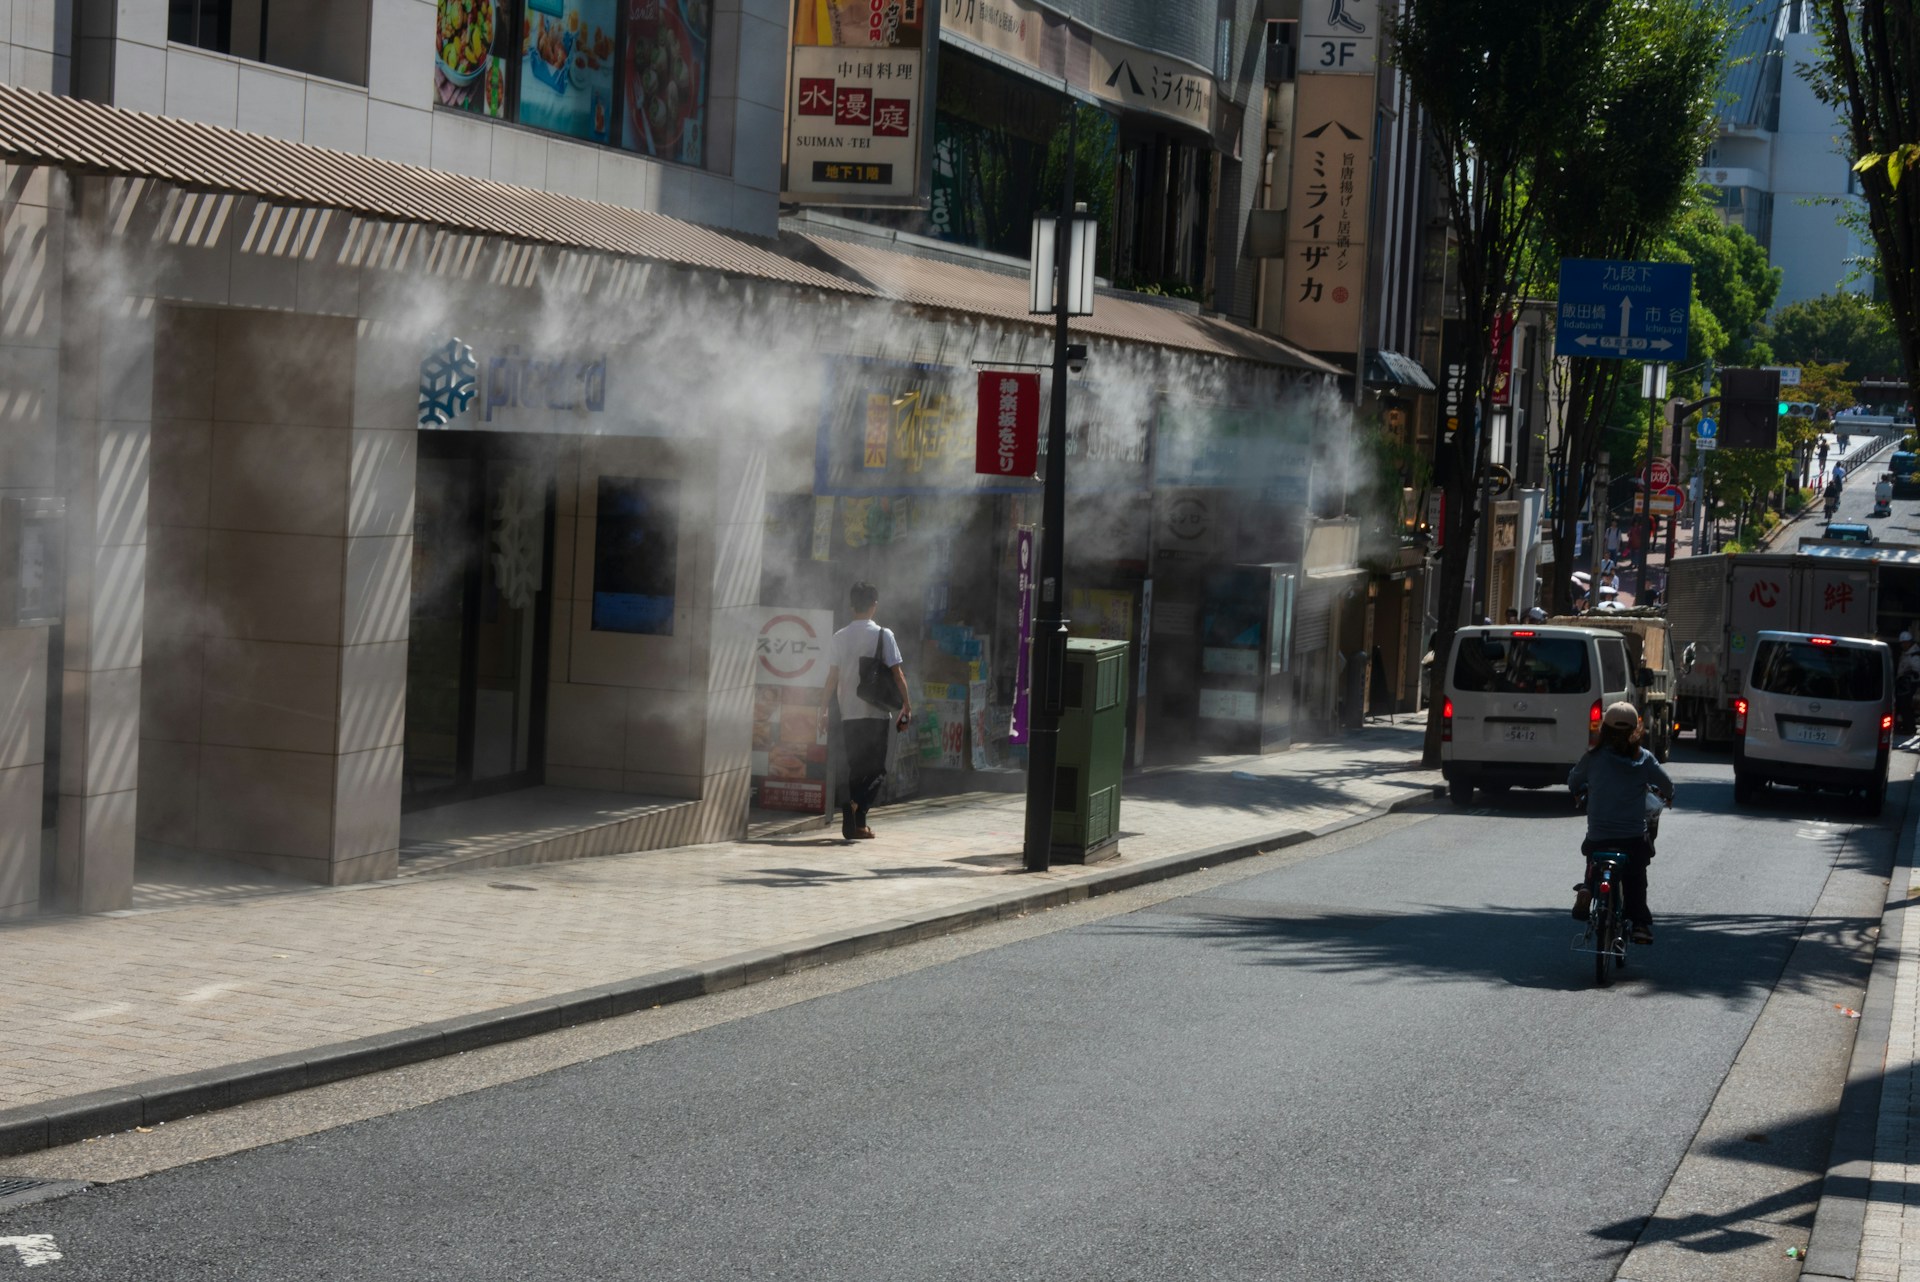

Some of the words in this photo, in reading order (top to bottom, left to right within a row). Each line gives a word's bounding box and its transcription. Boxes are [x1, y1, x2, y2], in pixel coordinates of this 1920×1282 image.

[1320, 41, 1357, 67] 3F
[838, 61, 912, 80] 中国料理
[1151, 66, 1203, 112] ミライザカ
[800, 84, 908, 132] 水漫庭
[796, 136, 843, 148] SUIMAN
[825, 164, 880, 181] 地下1階
[1337, 152, 1355, 271] 旨唐揚げと居酒メシ
[1299, 151, 1329, 303] ミライザカ
[1603, 265, 1653, 282] 九段下
[1602, 283, 1652, 293] Kudanshita
[1562, 303, 1606, 320] 飯田橋
[1563, 320, 1604, 330] Iidabashi
[1645, 324, 1682, 335] Ichigaya
[998, 378, 1019, 473] 神楽坂をどり
[1749, 580, 1780, 608] 心
[1824, 581, 1854, 614] 絆
[756, 637, 821, 655] スシロー
[942, 721, 963, 753] 698
